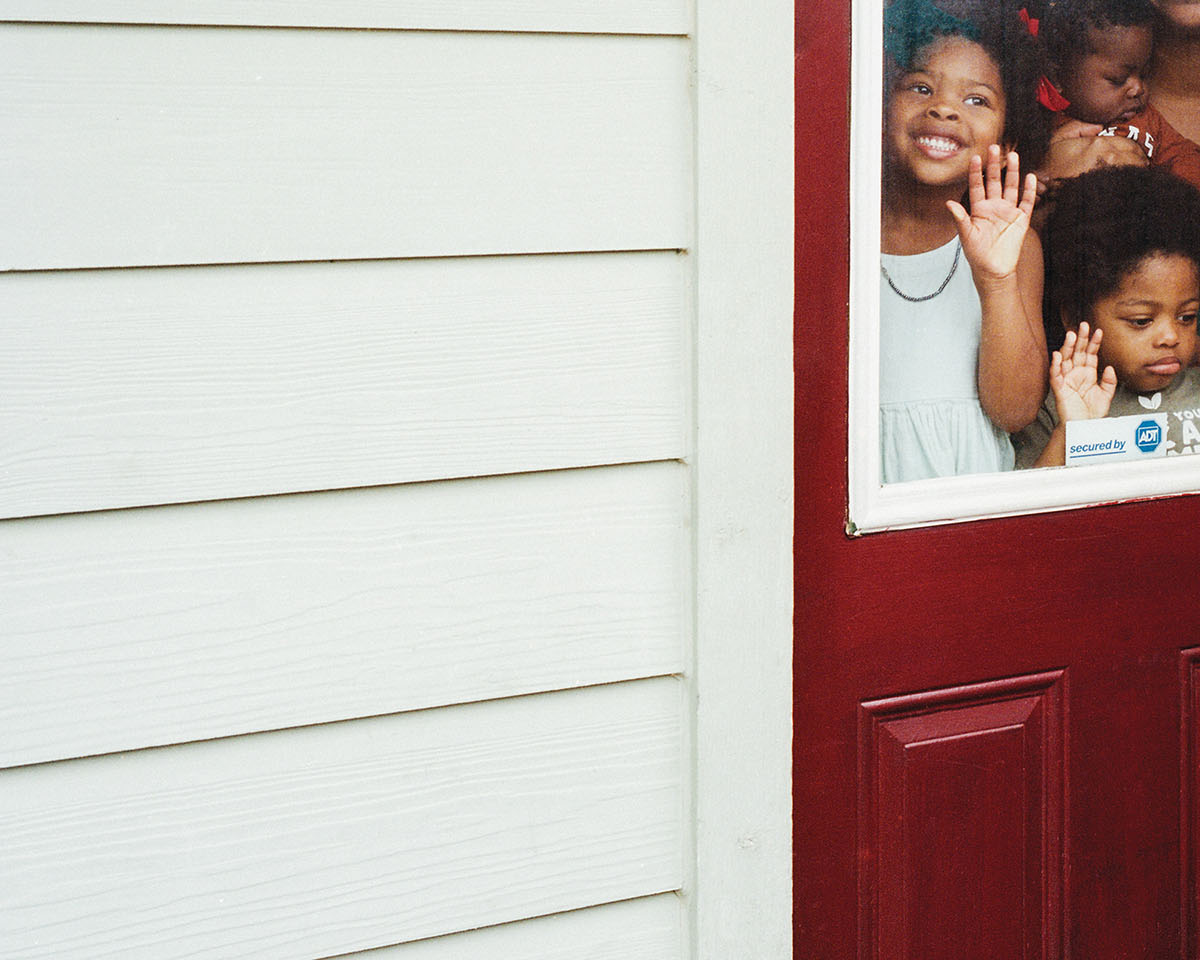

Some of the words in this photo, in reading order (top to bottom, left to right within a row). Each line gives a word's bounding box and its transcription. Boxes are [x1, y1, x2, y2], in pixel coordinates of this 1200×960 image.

[1138, 429, 1159, 443] ADT
[1069, 439, 1112, 454] secured
[1113, 439, 1127, 451] by
